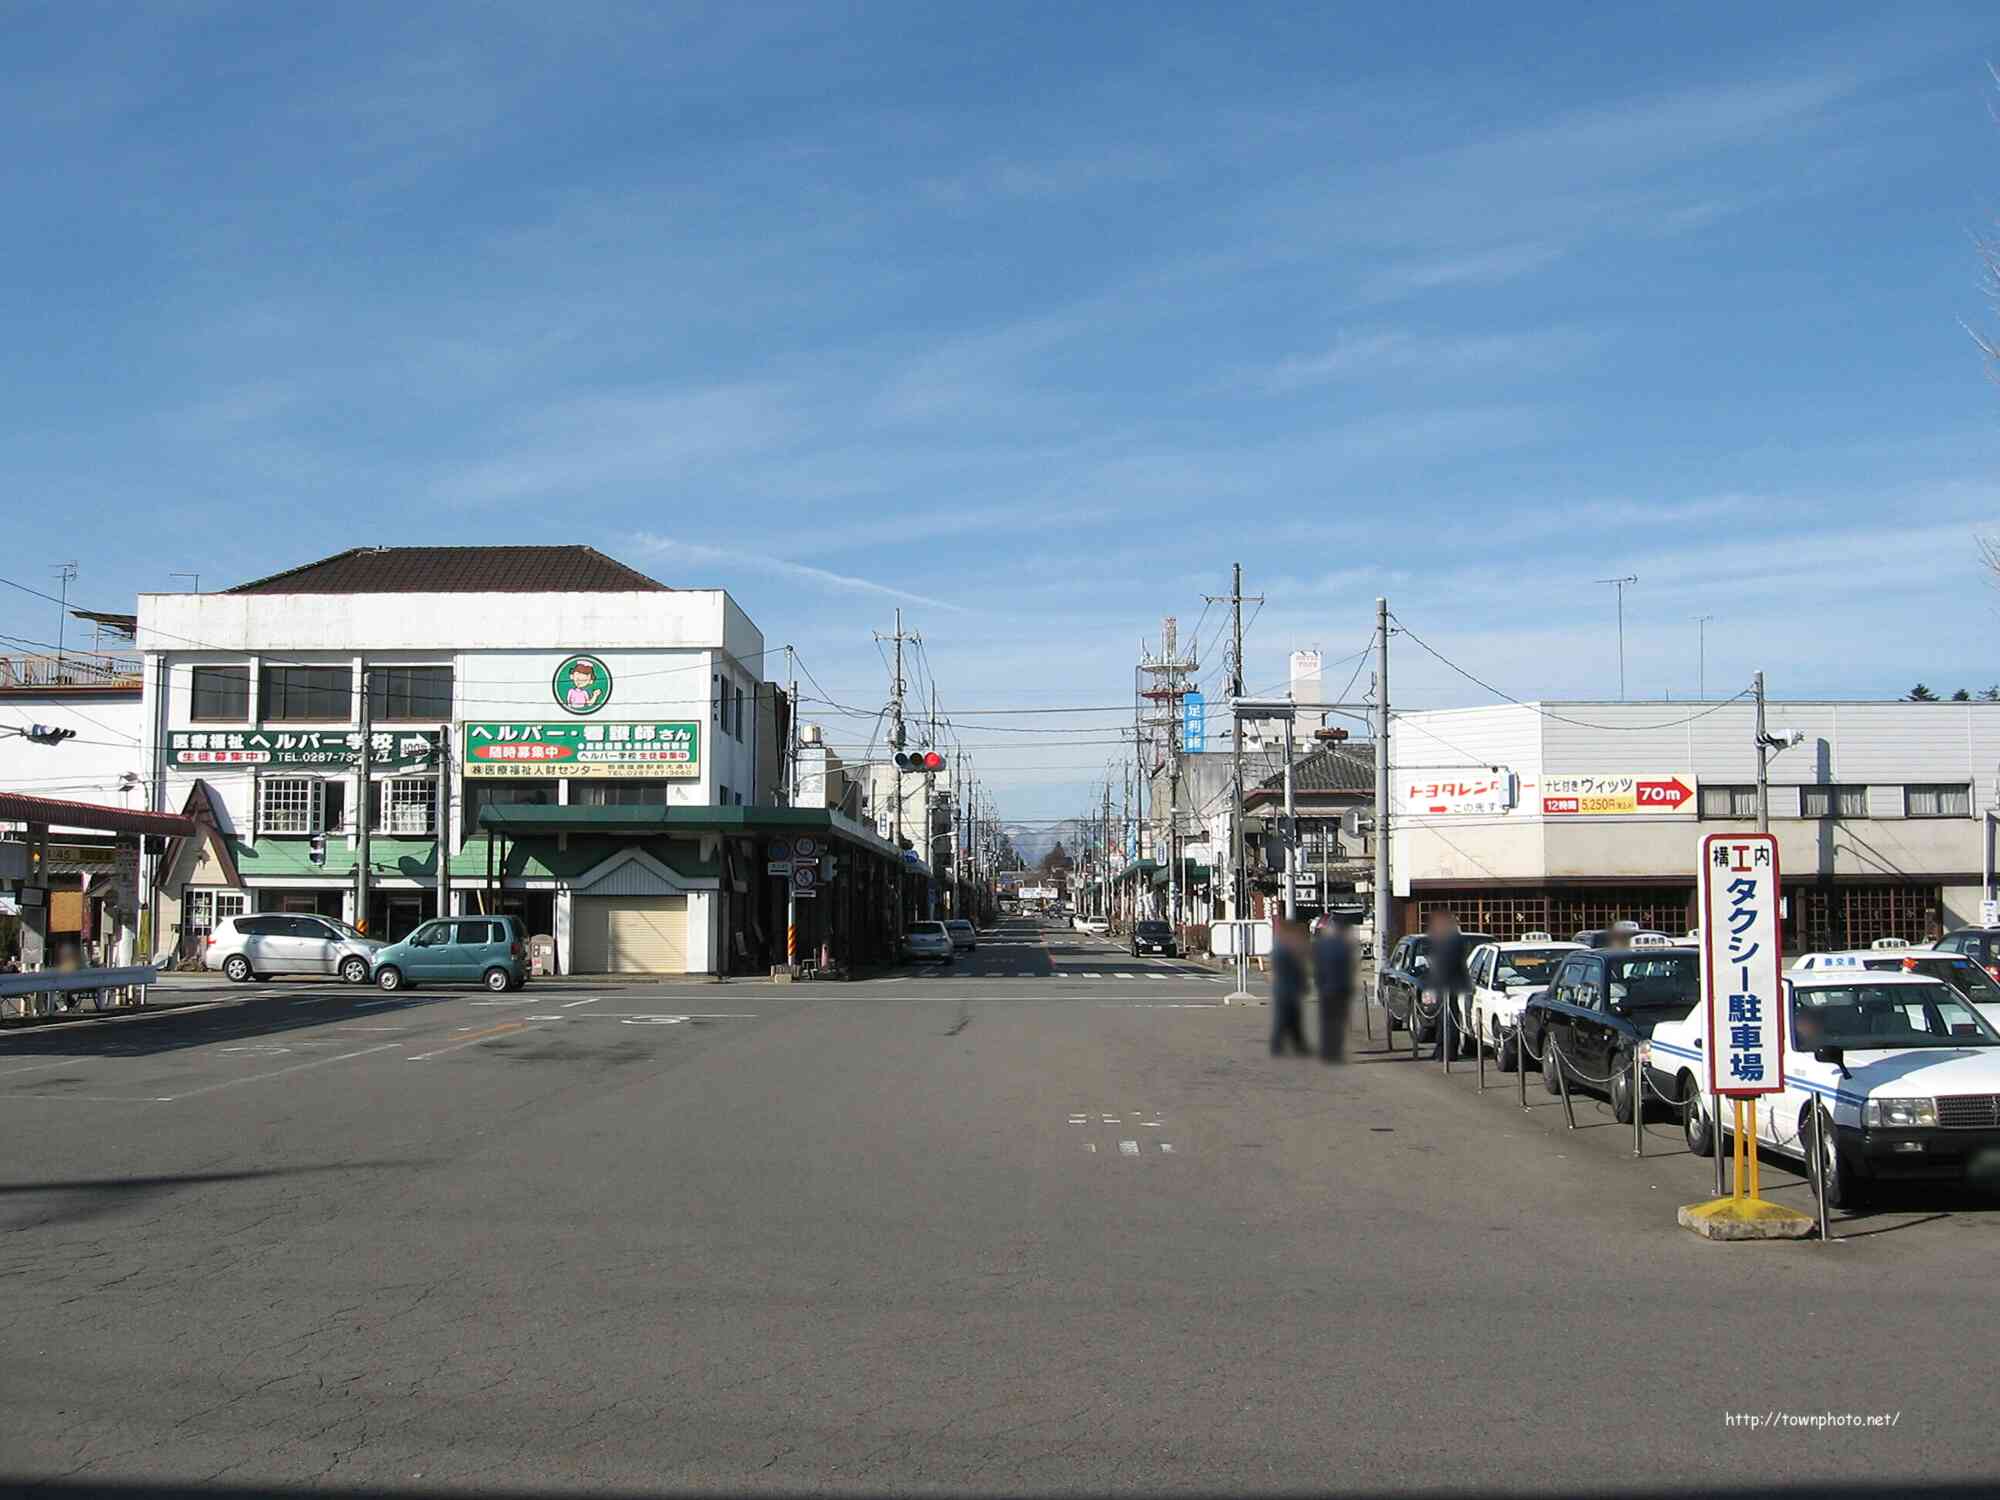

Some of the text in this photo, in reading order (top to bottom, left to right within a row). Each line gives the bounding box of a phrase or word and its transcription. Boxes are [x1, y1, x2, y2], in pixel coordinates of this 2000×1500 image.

[1581, 777, 1633, 793] ヴィッツ
[1640, 787, 1681, 801] 70m
[1727, 878, 1764, 1082] タクシー駐車場
